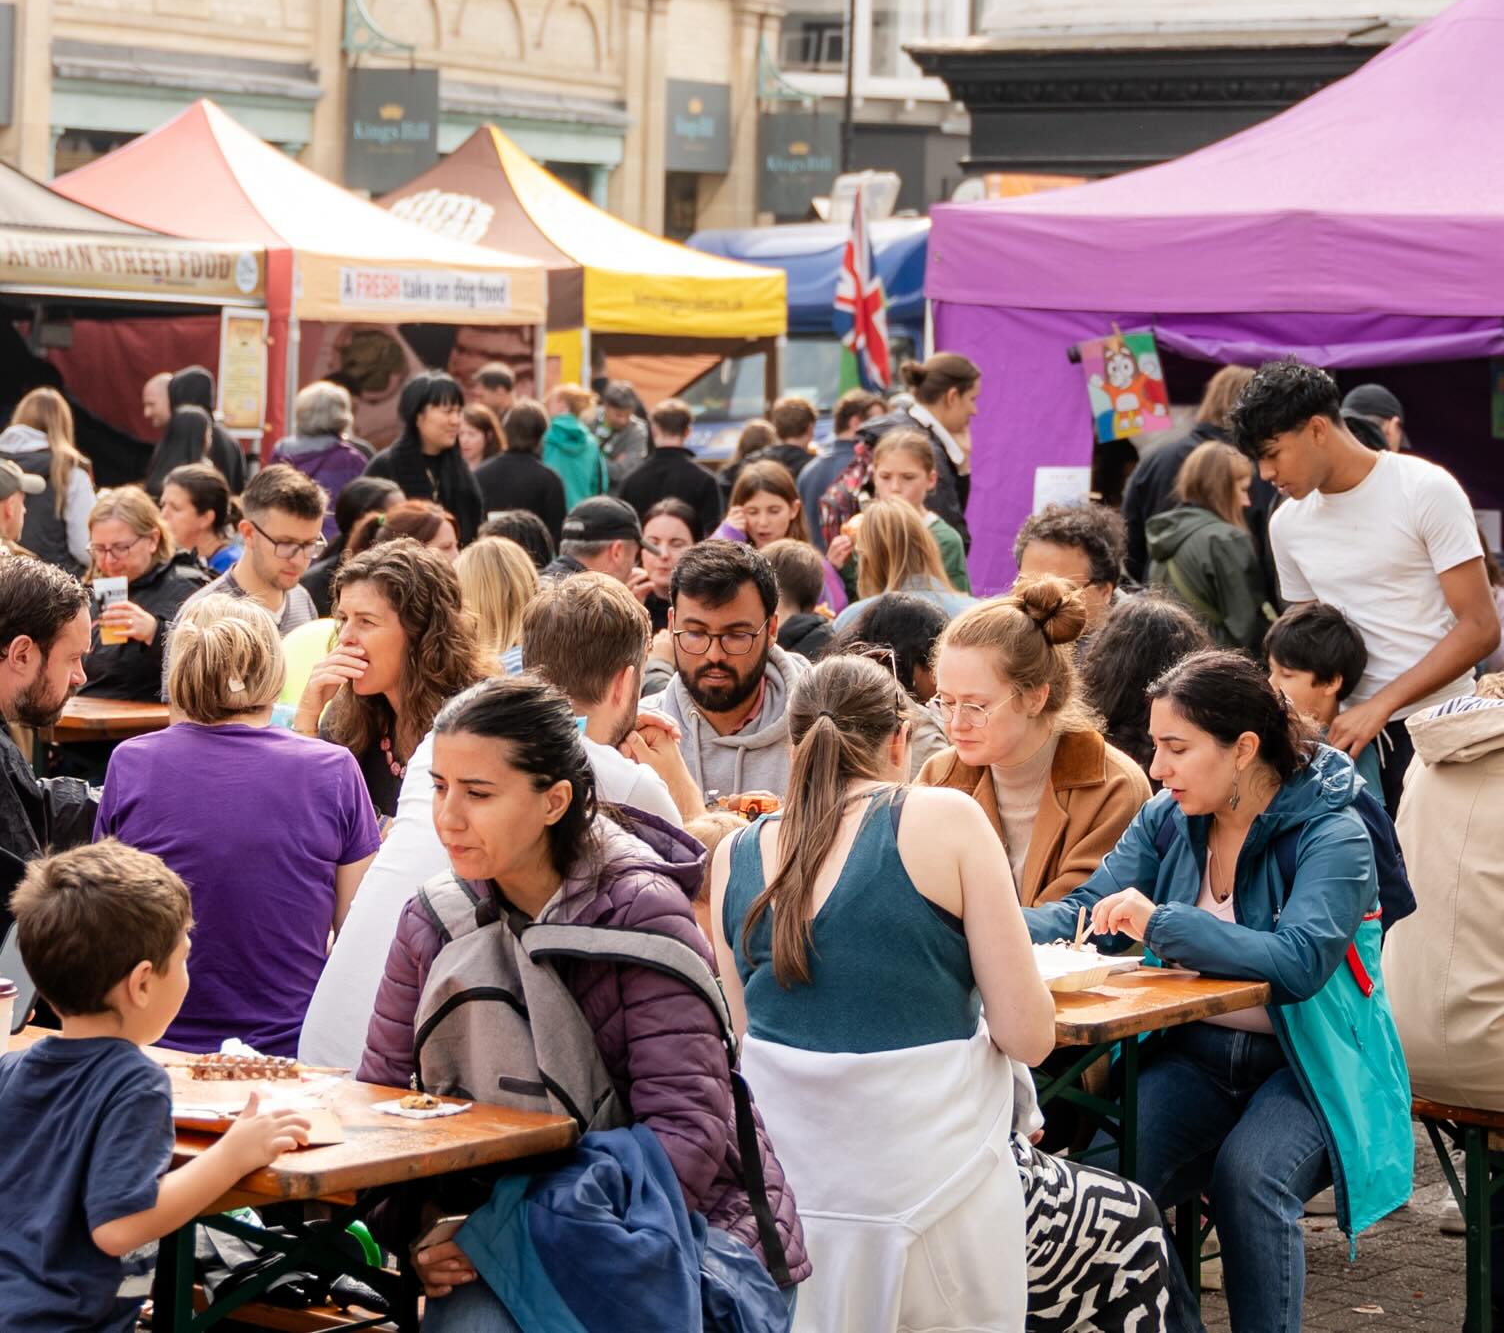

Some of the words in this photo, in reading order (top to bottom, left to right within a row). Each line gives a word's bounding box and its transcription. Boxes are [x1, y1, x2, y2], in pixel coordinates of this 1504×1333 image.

[7, 239, 93, 271] AFGHAN
[99, 244, 172, 277] STREET
[178, 250, 232, 280] FOOD
[355, 271, 399, 298] FRESH
[402, 275, 431, 300] take
[436, 281, 449, 300] on
[455, 277, 475, 308] dog
[478, 278, 505, 303] food
